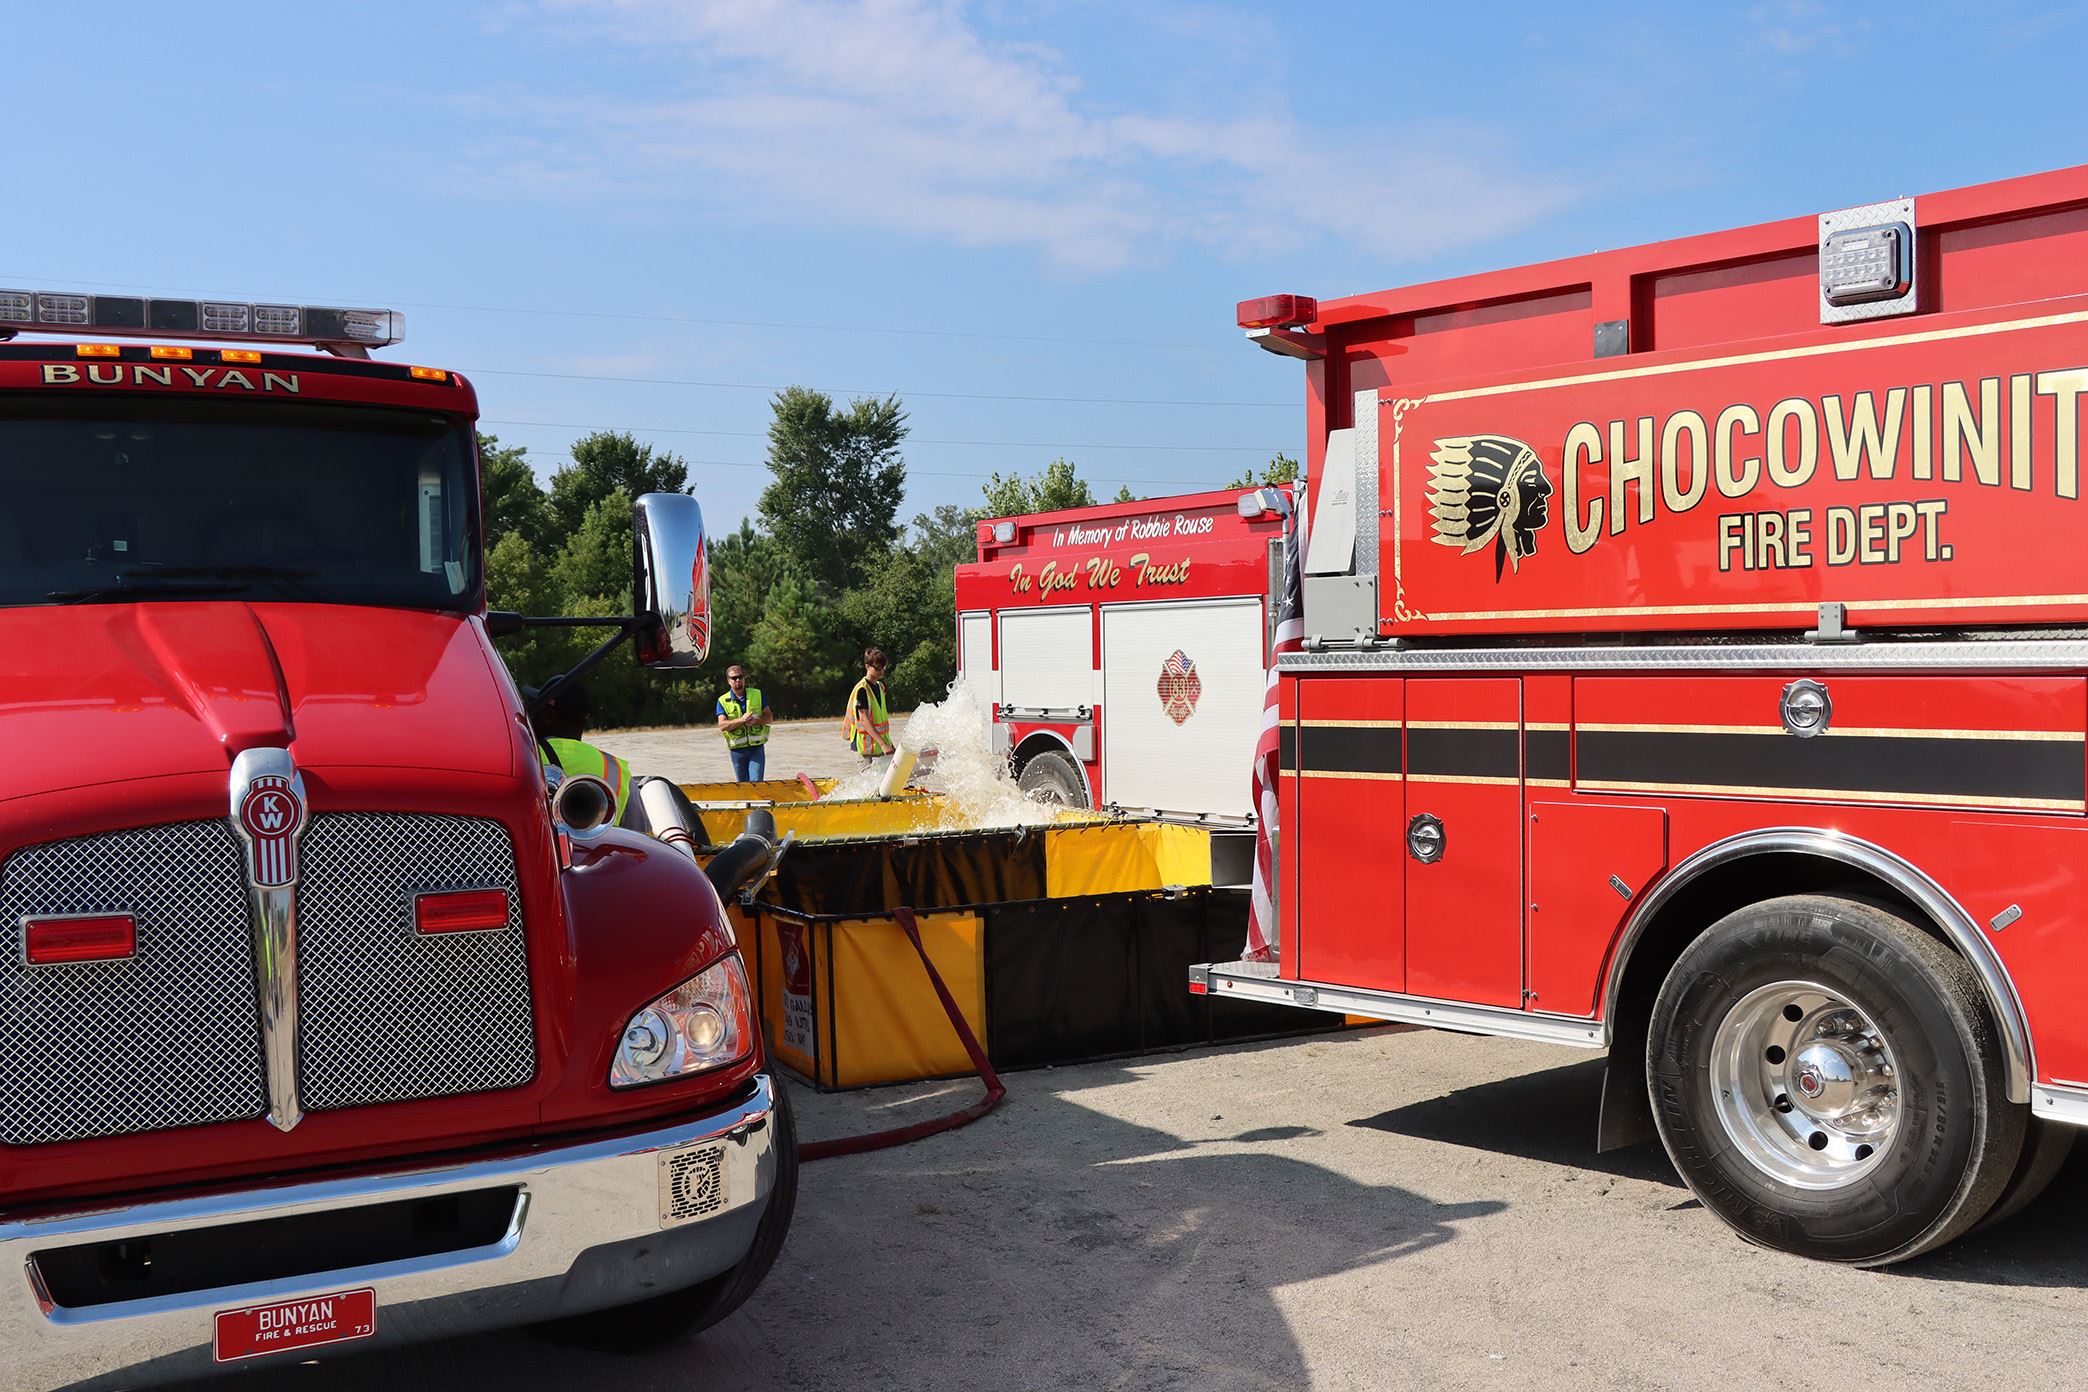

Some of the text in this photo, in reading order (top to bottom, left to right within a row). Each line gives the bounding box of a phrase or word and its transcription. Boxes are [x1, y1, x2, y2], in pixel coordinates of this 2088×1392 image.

[42, 364, 300, 394] BUNYAN
[1052, 514, 1215, 549] In Memory of Robbie Rouse
[1718, 498, 1954, 572] FIRE DEPT.
[1009, 552, 1192, 602] In God We Trust
[255, 1320, 337, 1342] FIRE & RESCUE
[259, 1300, 333, 1331] BUNYAN
[354, 1324, 370, 1334] 73
